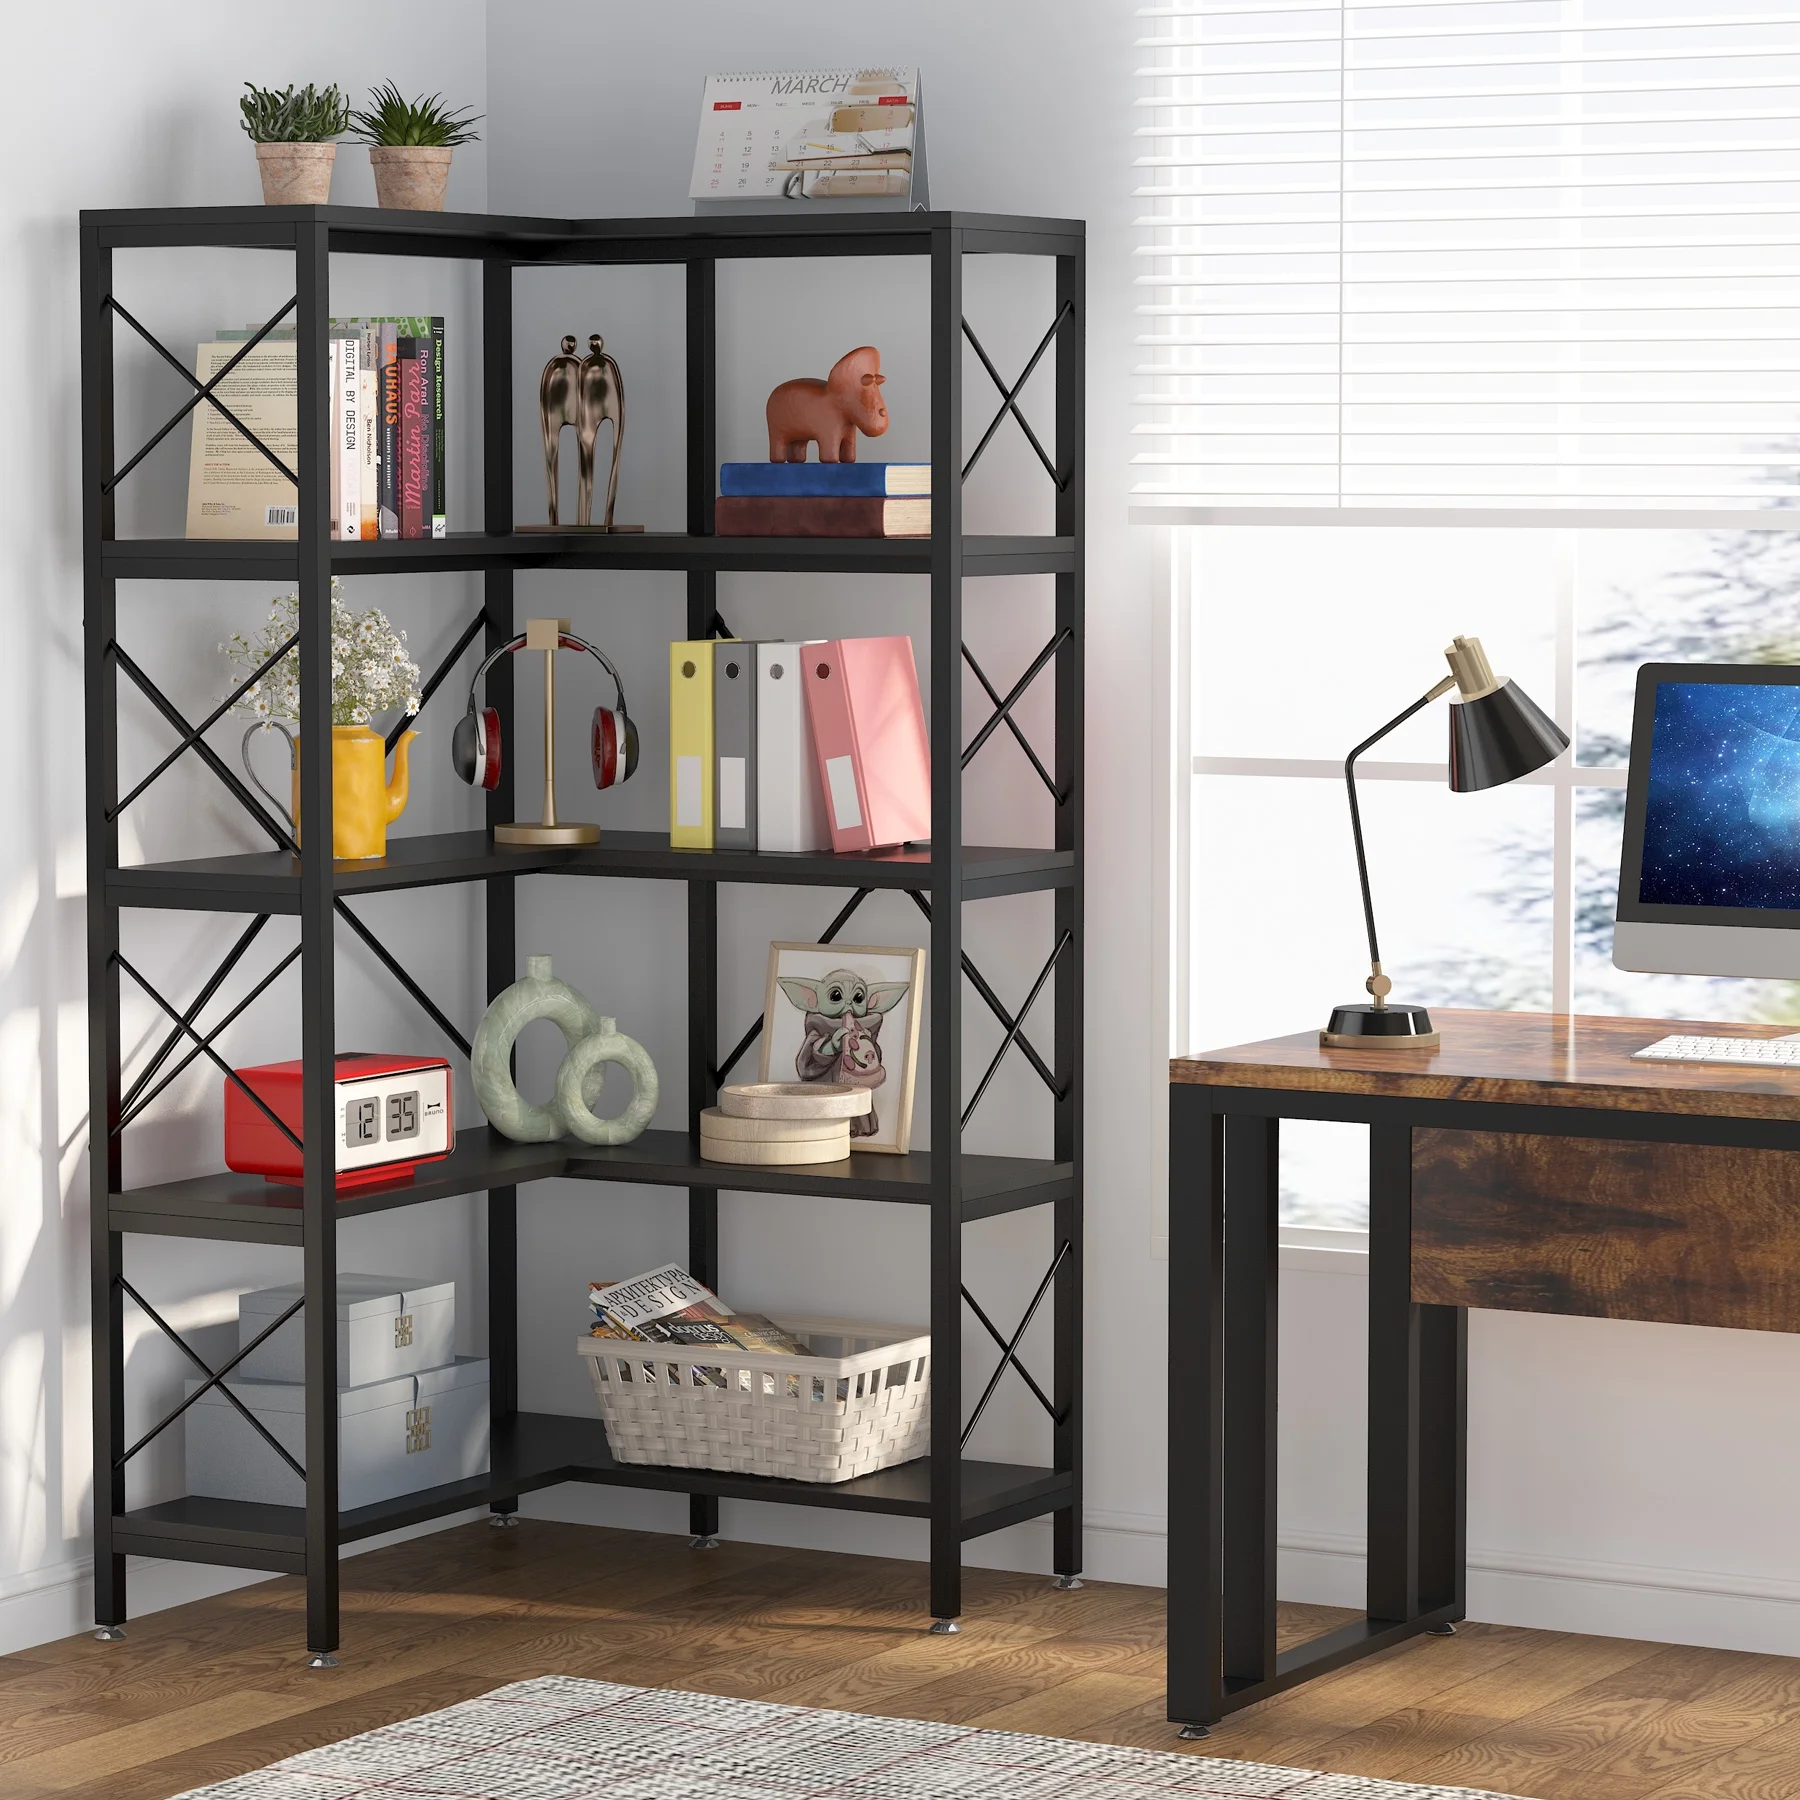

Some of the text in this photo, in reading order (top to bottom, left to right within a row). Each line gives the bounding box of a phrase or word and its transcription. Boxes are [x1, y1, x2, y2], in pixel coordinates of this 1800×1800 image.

[770, 77, 850, 95] MARCH
[345, 340, 355, 383] DIGITAL
[420, 349, 429, 374] Ron
[434, 339, 443, 373] Design
[345, 390, 355, 403] BY
[385, 343, 397, 425] BAUHAUS
[404, 362, 421, 419] Parr
[420, 377, 429, 406] Arad
[435, 375, 443, 420] Research
[345, 409, 356, 450] DESIGN
[404, 425, 421, 505] Martin
[359, 1096, 414, 1138] 12 35
[603, 1268, 690, 1307] АРХИТЕКТУРА
[620, 1280, 702, 1318] DESIGN
[667, 1321, 720, 1334] domus
[693, 1331, 734, 1344] design
